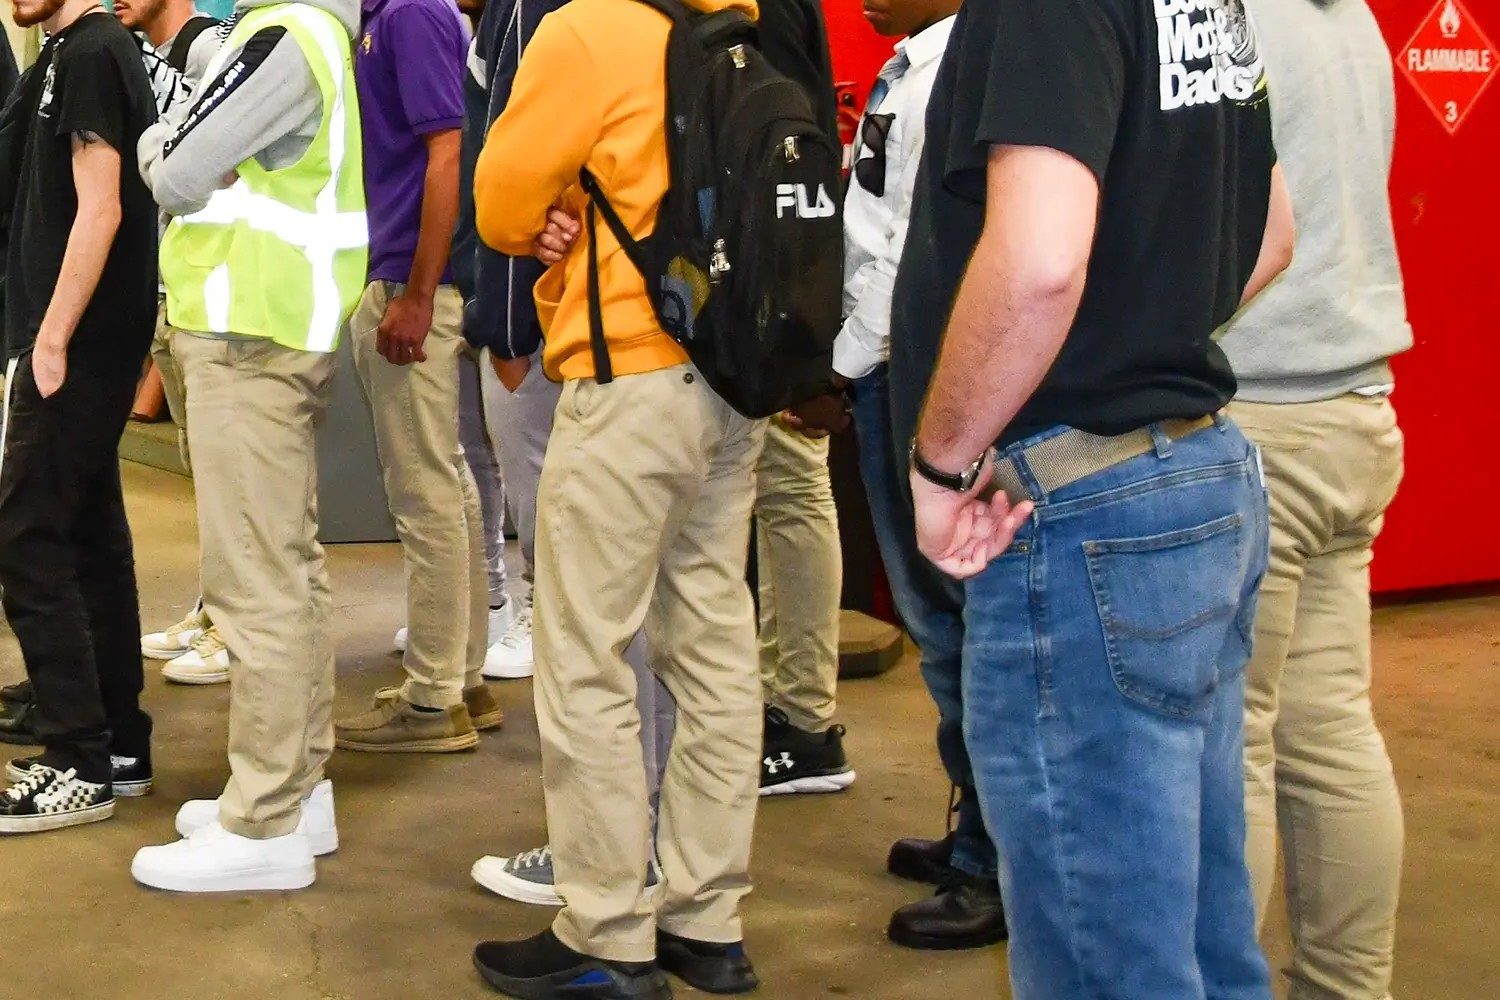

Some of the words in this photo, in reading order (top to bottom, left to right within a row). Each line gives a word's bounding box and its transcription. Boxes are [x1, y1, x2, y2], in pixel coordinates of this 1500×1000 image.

[1408, 48, 1490, 72] FLAMMABLE
[1445, 101, 1458, 122] 3
[776, 182, 836, 219] FILA
